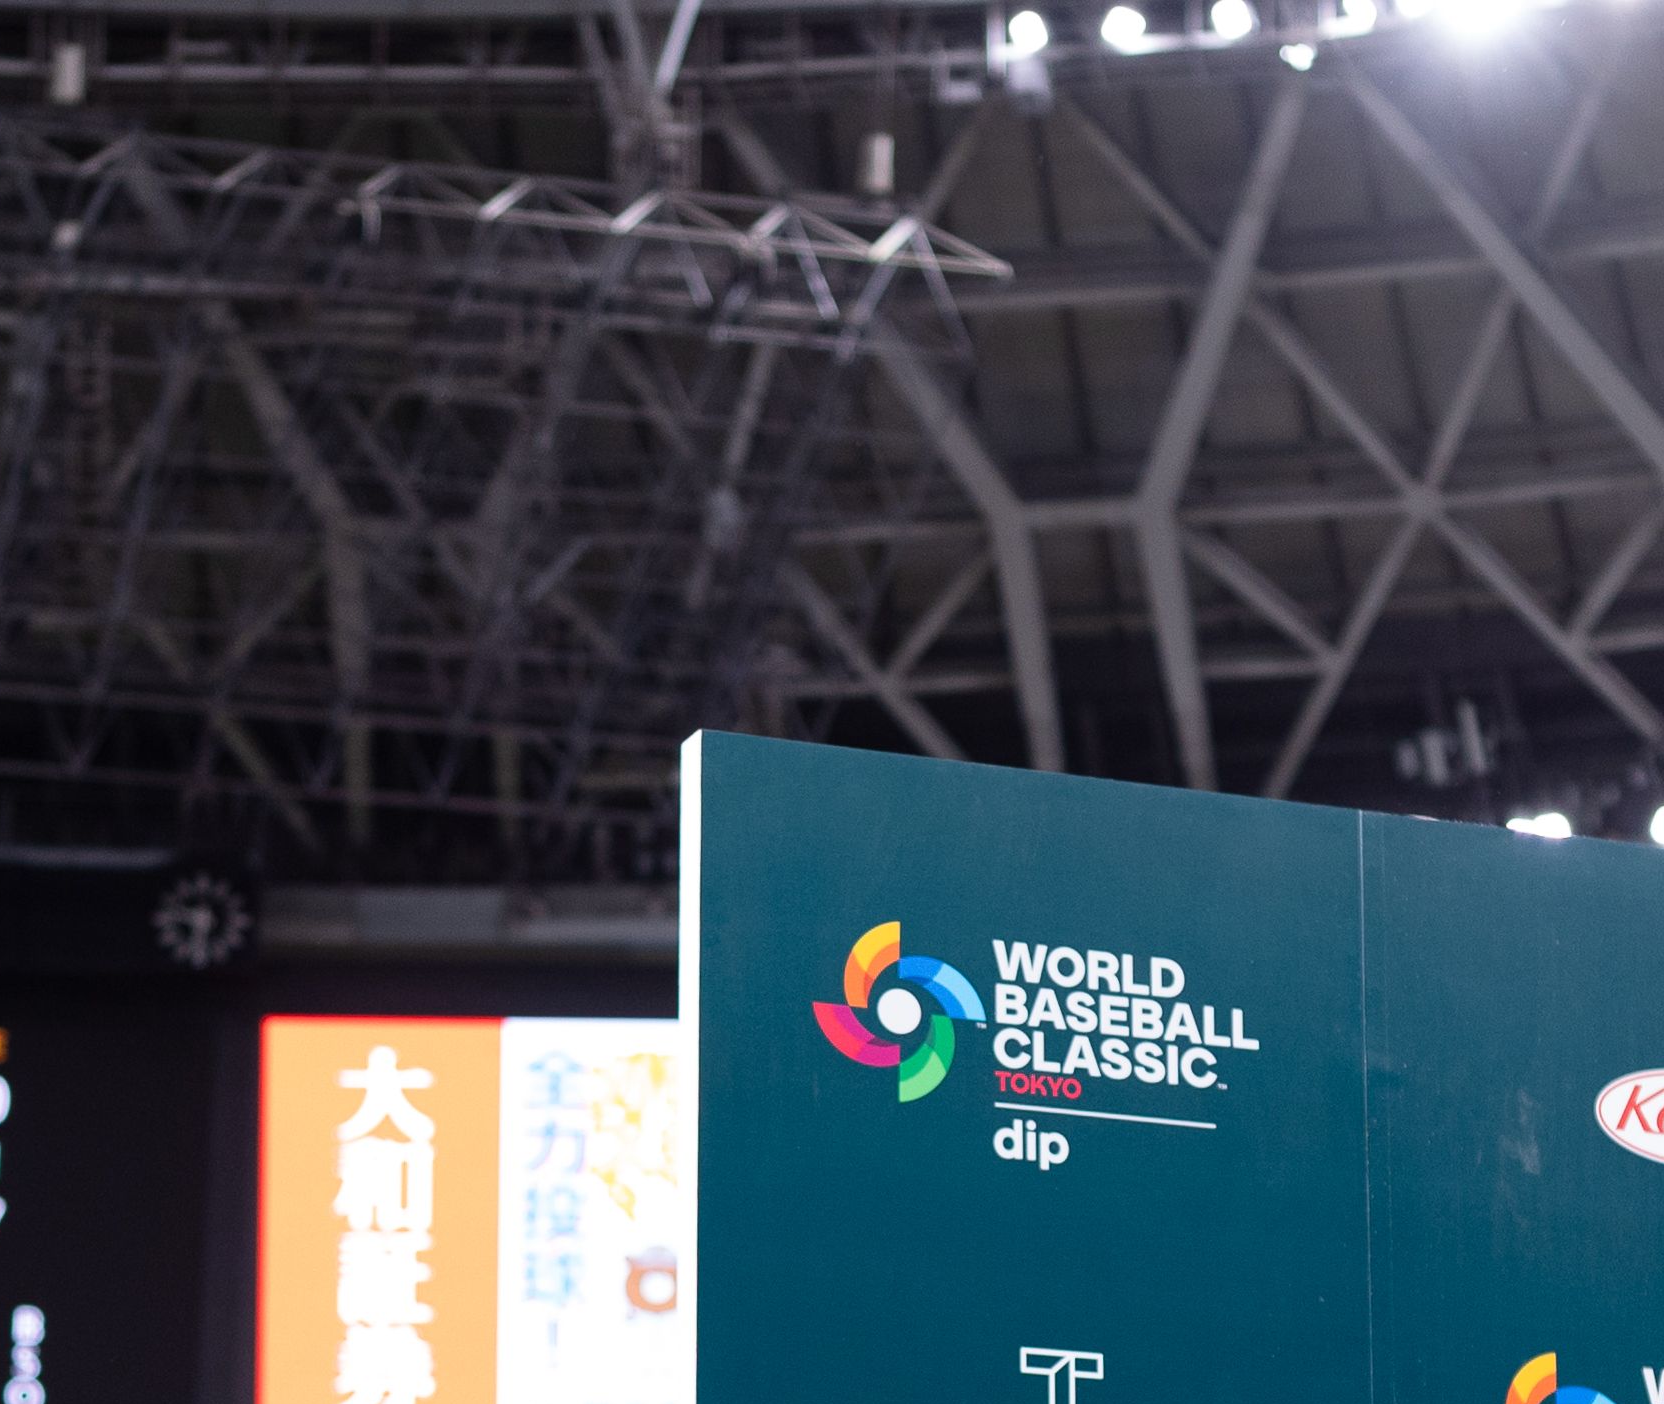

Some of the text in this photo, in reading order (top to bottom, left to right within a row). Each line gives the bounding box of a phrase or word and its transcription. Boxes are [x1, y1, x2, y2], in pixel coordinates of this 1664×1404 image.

[993, 939, 1185, 998] WORLD
[995, 983, 1260, 1051] BASEBALL
[993, 1028, 1218, 1089] CLASSIC
[994, 1070, 1083, 1100] TOKYO
[992, 1119, 1070, 1171] dip
